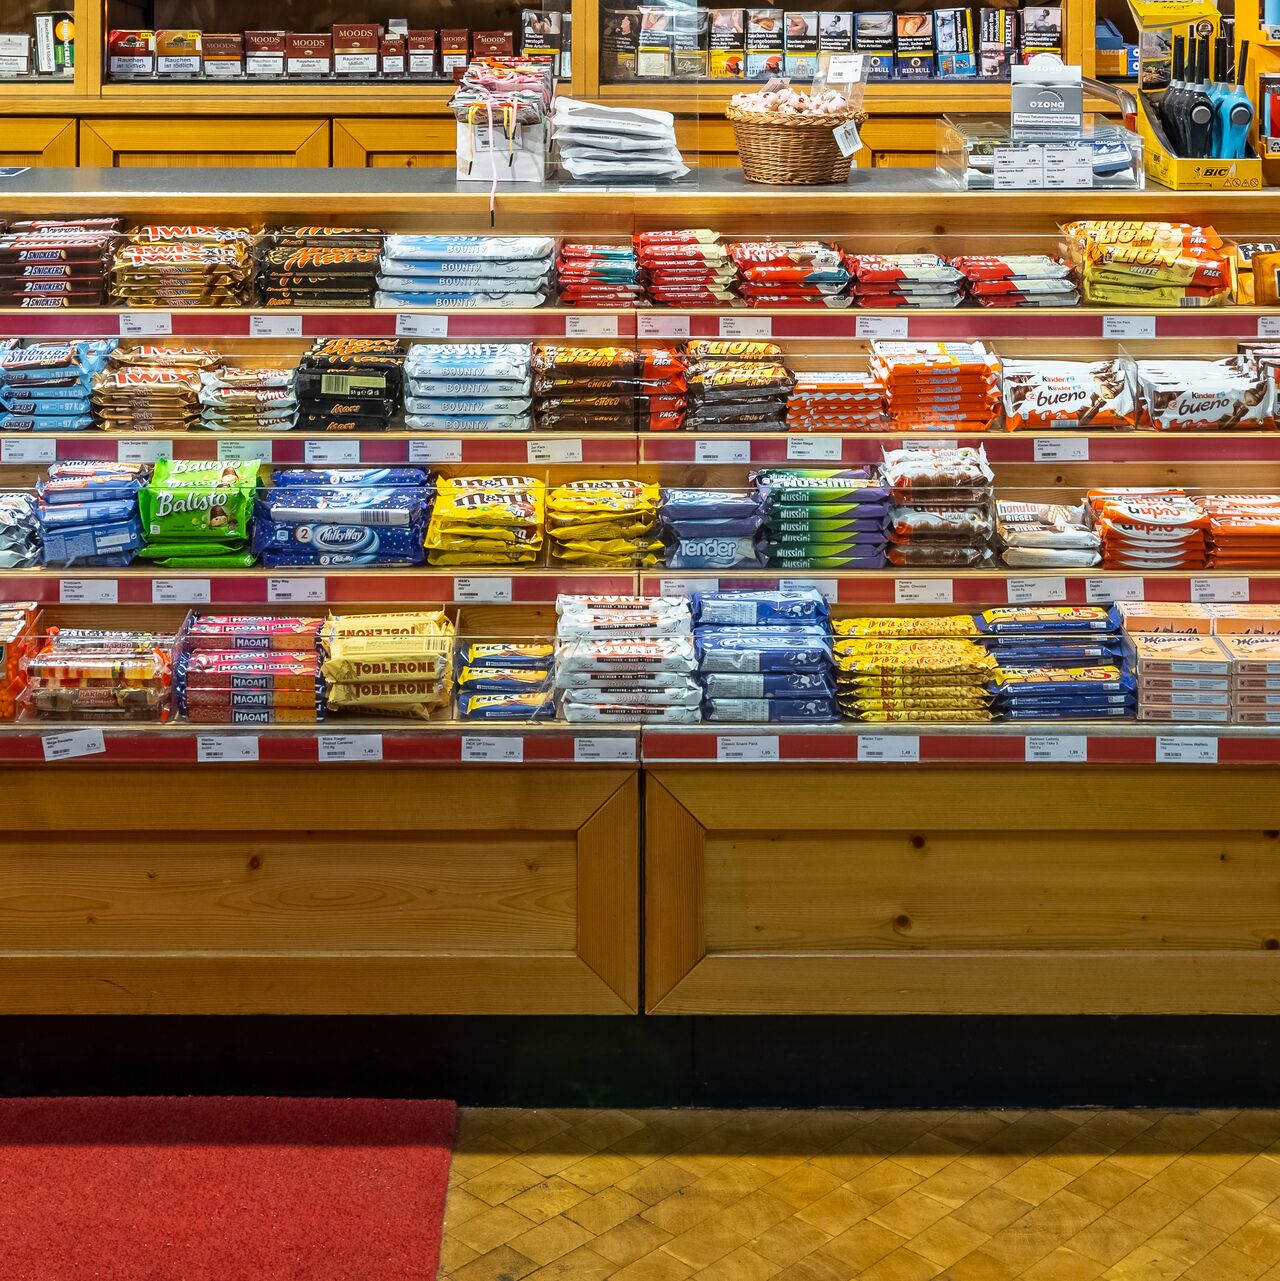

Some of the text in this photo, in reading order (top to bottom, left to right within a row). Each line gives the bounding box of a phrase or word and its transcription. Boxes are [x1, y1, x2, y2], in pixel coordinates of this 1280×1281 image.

[339, 29, 375, 38] MOODS
[292, 39, 326, 47] MOODS
[1203, 167, 1228, 177] BIC
[446, 244, 488, 255] BOUNTY
[1129, 266, 1159, 275] WHITE
[588, 359, 613, 367] CHOCO
[1036, 389, 1087, 408] bueno
[781, 492, 810, 501] Nussini
[155, 492, 228, 518] Balisto
[998, 502, 1037, 514] hanuta
[1005, 514, 1033, 522] RIEGEL
[354, 662, 436, 676] TOBLERONE
[236, 677, 267, 688] MAOAM
